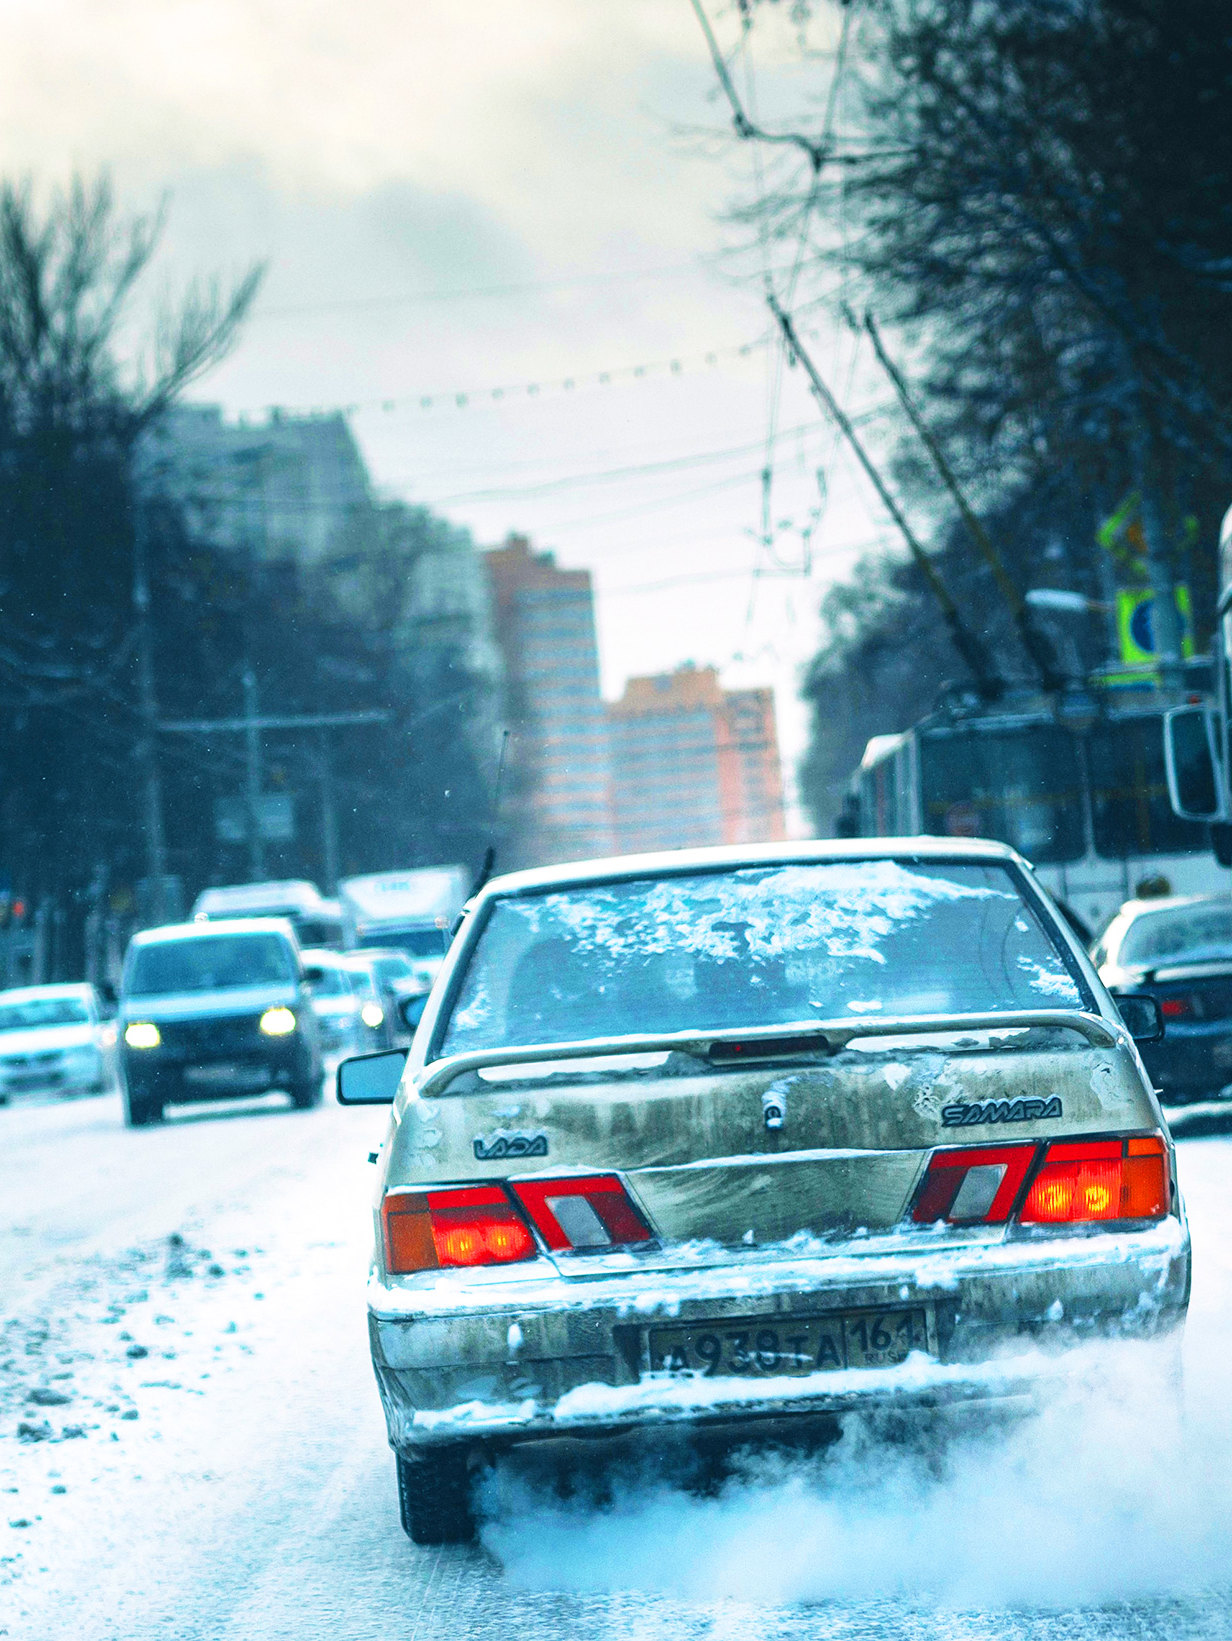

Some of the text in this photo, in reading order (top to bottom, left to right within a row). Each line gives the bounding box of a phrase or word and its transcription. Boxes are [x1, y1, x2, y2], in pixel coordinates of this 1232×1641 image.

[942, 1096, 1063, 1127] SAMARA
[473, 1134, 548, 1160] LADA
[849, 1311, 913, 1352] 161
